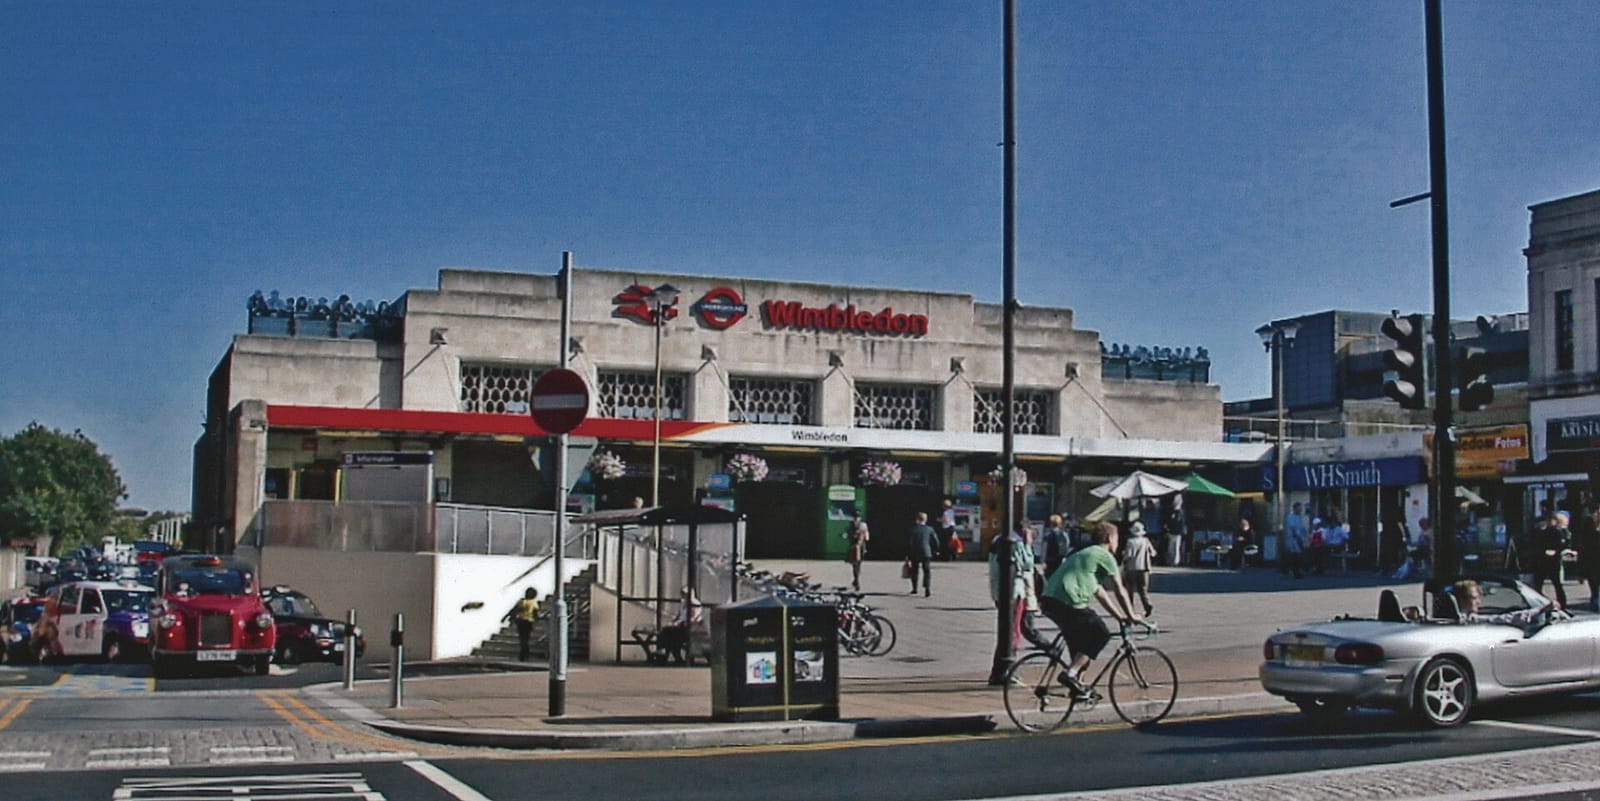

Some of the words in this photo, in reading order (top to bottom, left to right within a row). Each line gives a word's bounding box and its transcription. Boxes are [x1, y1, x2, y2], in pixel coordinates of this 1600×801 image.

[765, 300, 928, 335] Wimbledon
[791, 429, 848, 442] Wimbledon
[1494, 435, 1522, 449] Fotos
[1303, 458, 1381, 488] WHSmith
